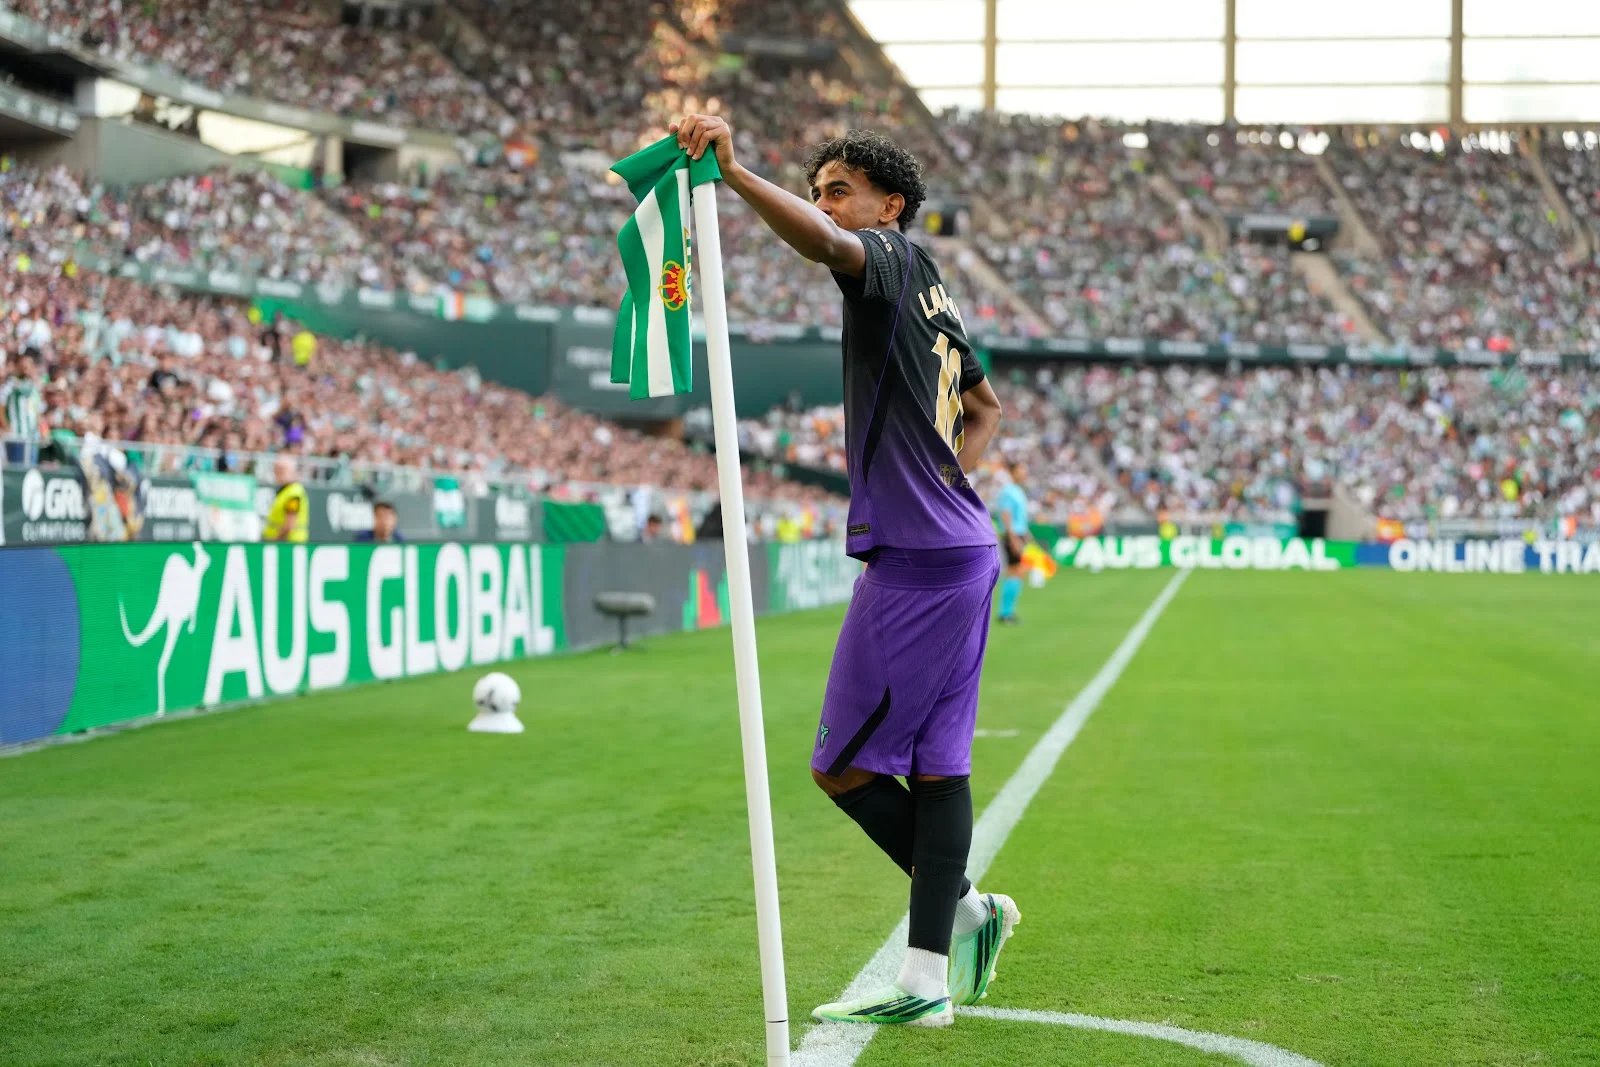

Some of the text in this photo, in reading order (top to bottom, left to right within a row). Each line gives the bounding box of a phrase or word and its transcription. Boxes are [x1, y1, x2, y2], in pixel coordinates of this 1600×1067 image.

[1073, 535, 1341, 571] AUS GLOBAL
[1387, 538, 1527, 574] ONLINE
[203, 542, 555, 706] AUS GLOBAL
